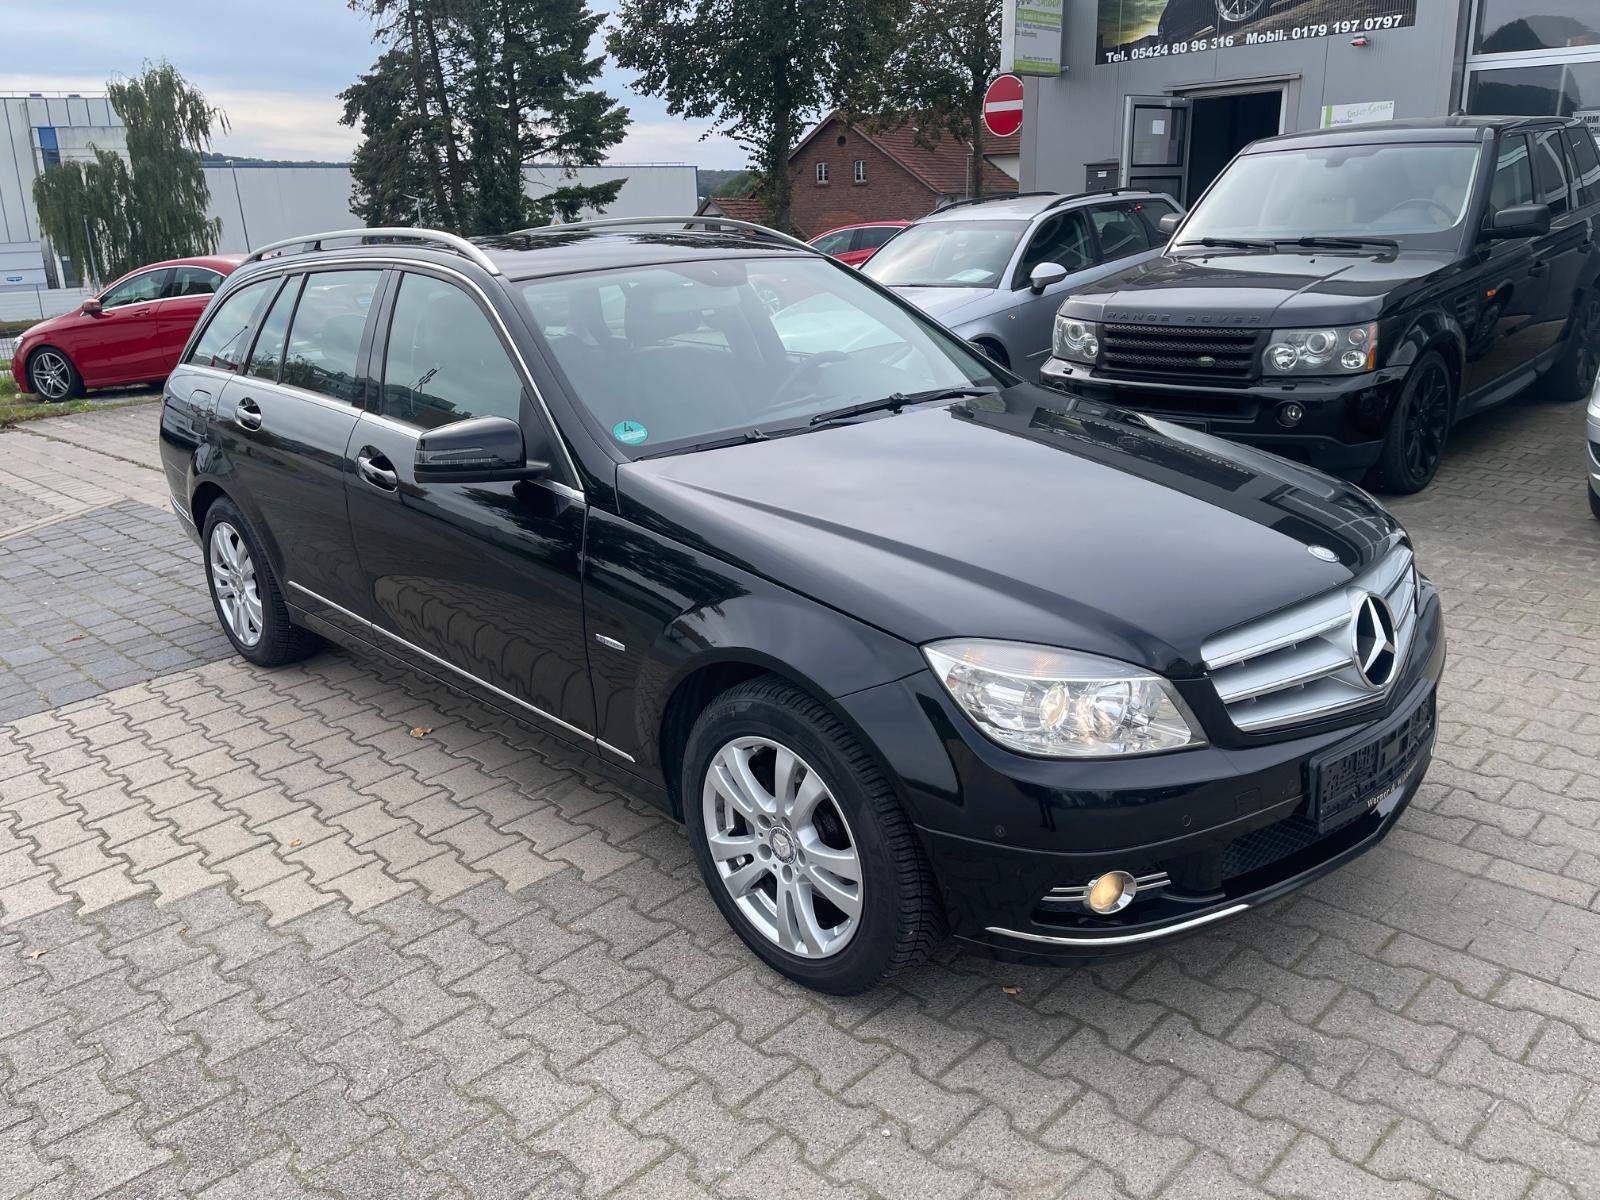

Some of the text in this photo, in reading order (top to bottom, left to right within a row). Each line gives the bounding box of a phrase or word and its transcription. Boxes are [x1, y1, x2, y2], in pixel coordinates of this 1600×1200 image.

[1106, 14, 1403, 63] Tel. 05424 80 96 316 Mobil. 0179 197 0797
[1107, 312, 1262, 324] RANGE ROVER
[623, 422, 634, 432] 4
